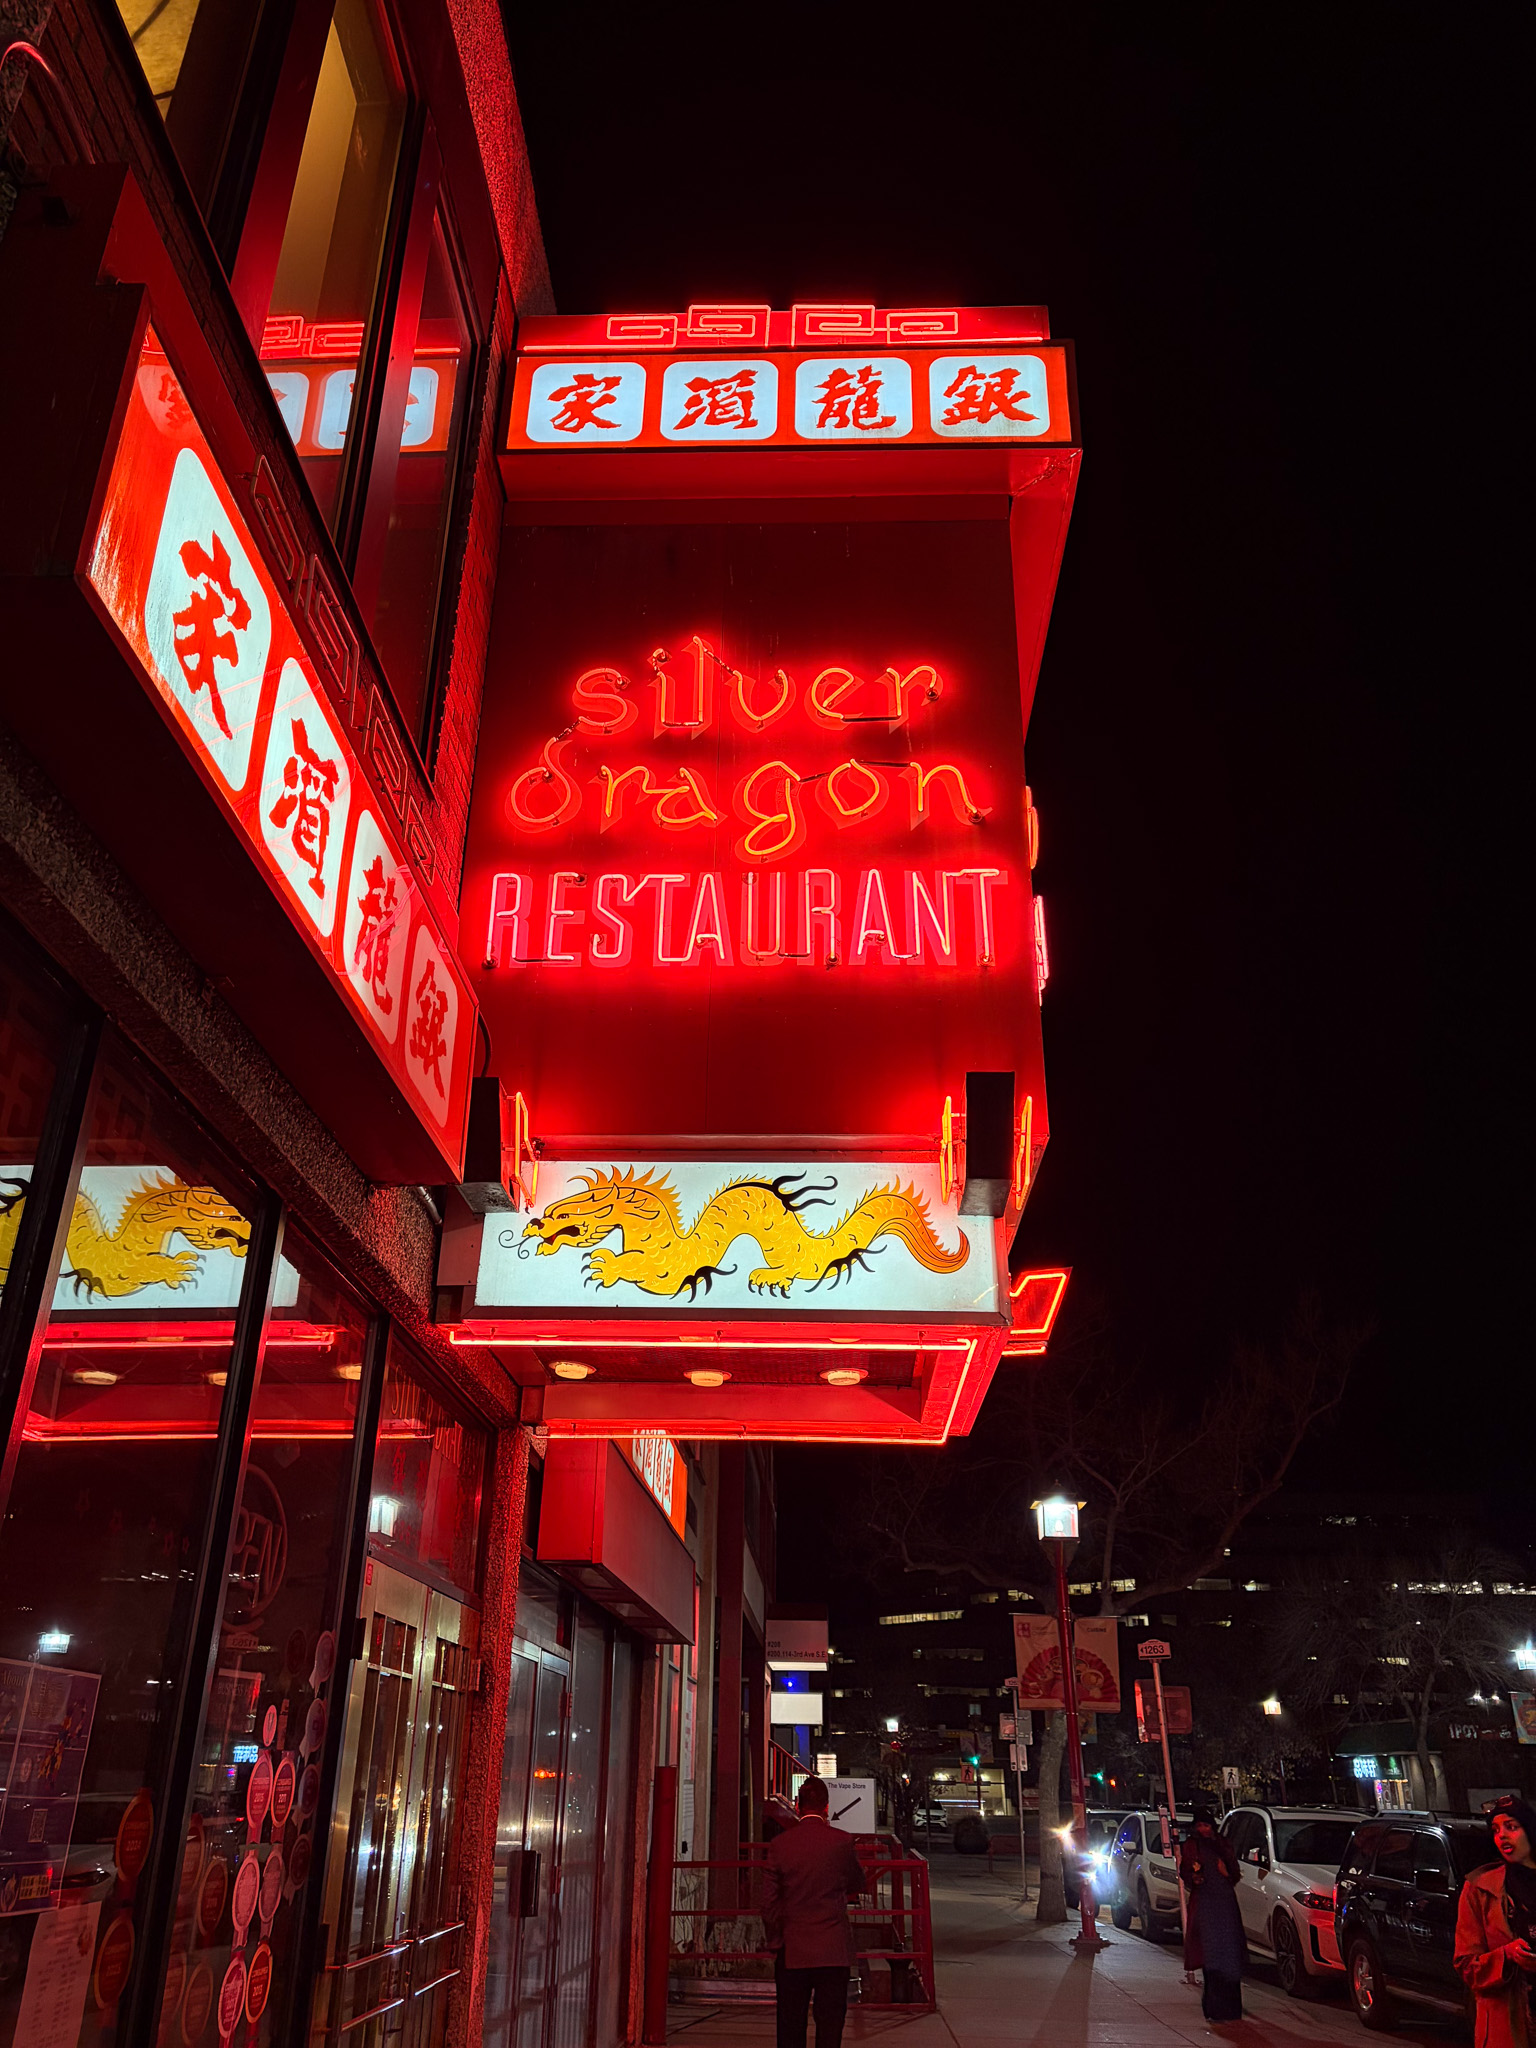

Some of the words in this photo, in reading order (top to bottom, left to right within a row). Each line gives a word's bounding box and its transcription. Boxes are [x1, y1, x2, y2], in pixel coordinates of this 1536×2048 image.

[572, 637, 944, 740] silver
[506, 738, 993, 863] dragon
[484, 868, 1008, 968] RESTAURANT
[1144, 1645, 1165, 1654] 1263
[838, 1782, 851, 1790] Vape
